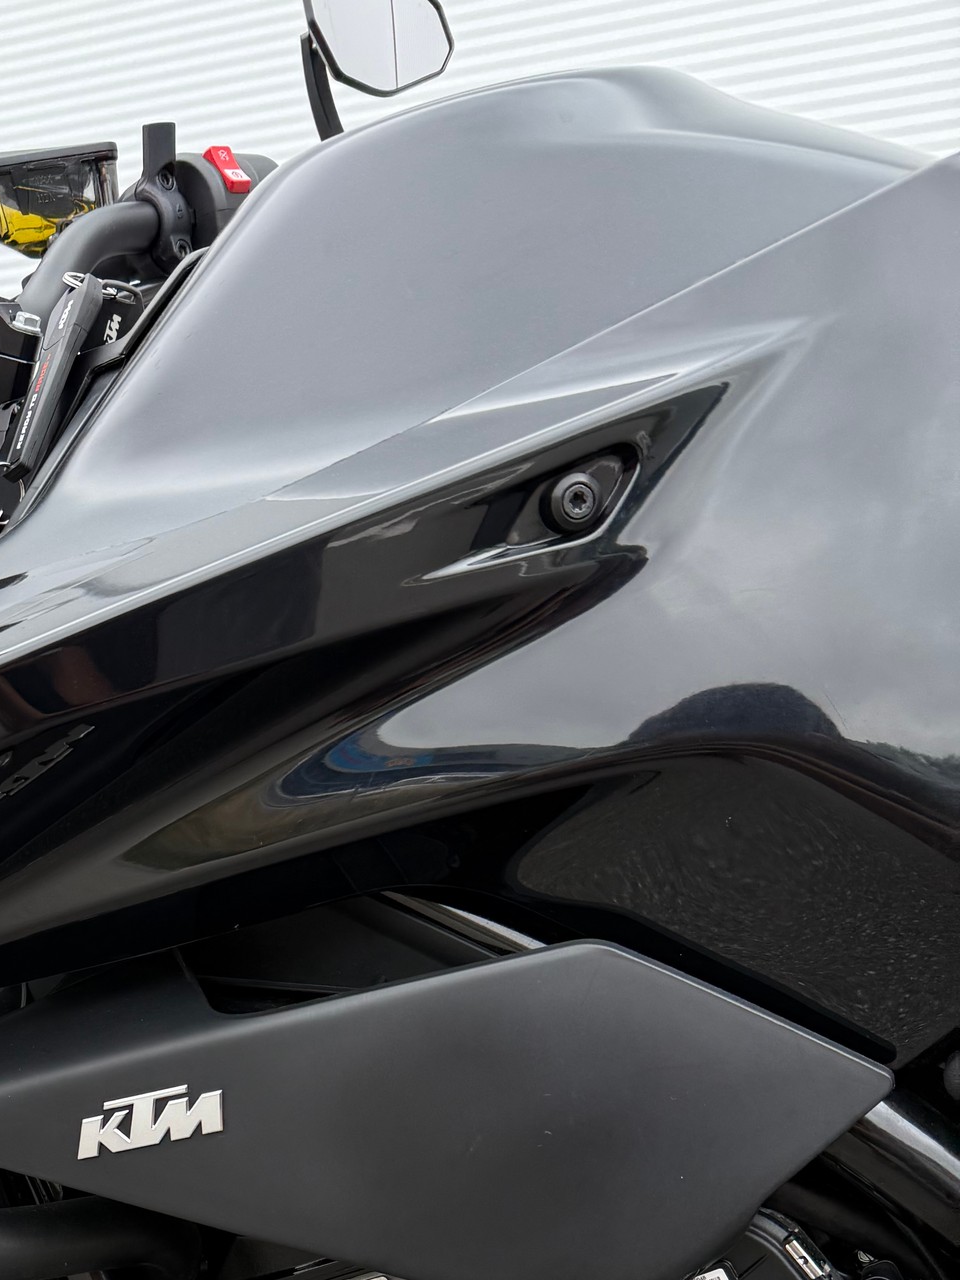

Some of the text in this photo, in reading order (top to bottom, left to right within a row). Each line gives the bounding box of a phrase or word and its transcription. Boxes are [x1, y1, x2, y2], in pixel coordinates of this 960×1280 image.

[58, 299, 74, 329] KTM
[15, 361, 49, 450] READY TO RACE
[78, 1084, 223, 1160] KTM
